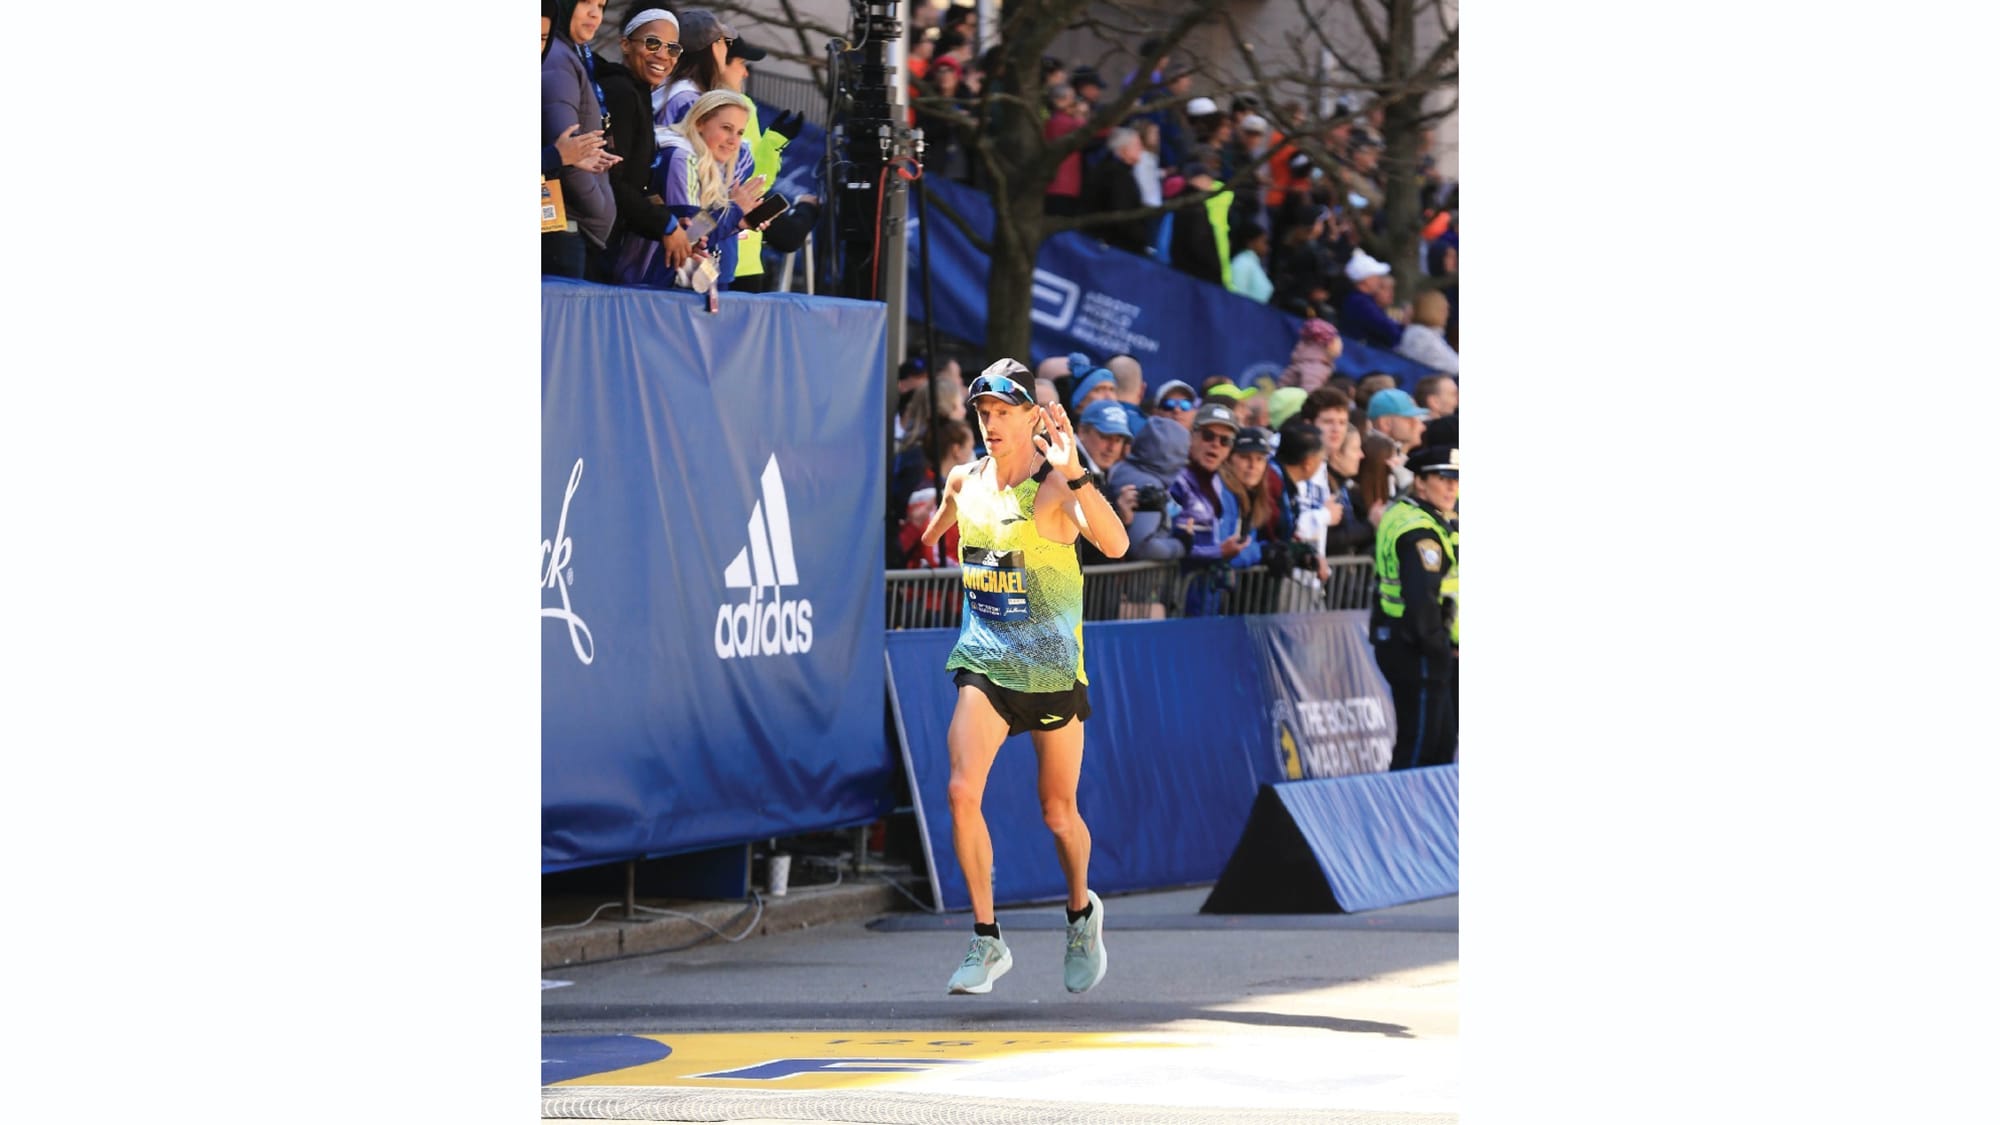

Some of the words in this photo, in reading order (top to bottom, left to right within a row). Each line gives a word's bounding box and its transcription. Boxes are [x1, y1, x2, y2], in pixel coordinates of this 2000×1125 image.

[963, 565, 1026, 594] MICHAEL
[714, 584, 813, 659] adidas
[1297, 701, 1328, 736] THE
[1321, 697, 1387, 735] BOSTON
